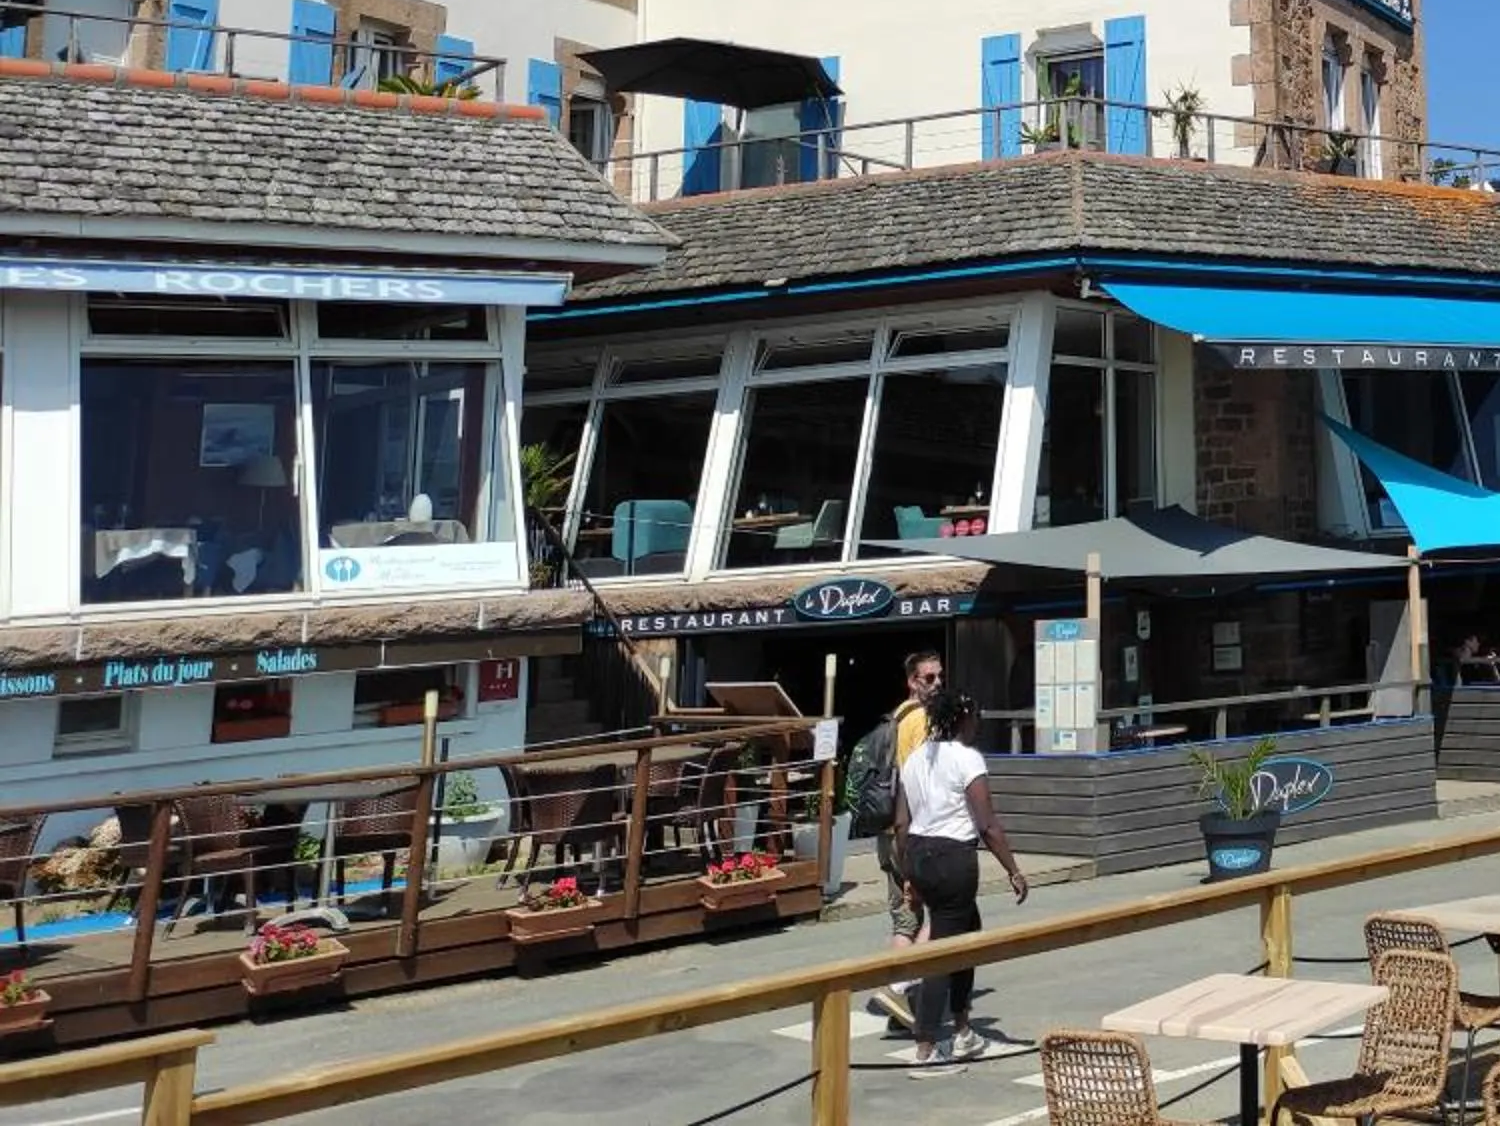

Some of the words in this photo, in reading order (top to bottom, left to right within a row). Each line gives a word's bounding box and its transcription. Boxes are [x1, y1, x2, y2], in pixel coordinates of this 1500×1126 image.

[155, 270, 445, 300] ROCHERS
[819, 581, 882, 615] Duplex
[620, 608, 786, 632] RESTAURANT
[901, 598, 950, 615] BAR
[104, 659, 149, 687] Plats
[151, 657, 174, 683] du
[174, 656, 214, 686] jour
[256, 648, 317, 673] Salades
[1249, 764, 1321, 811] Duplex
